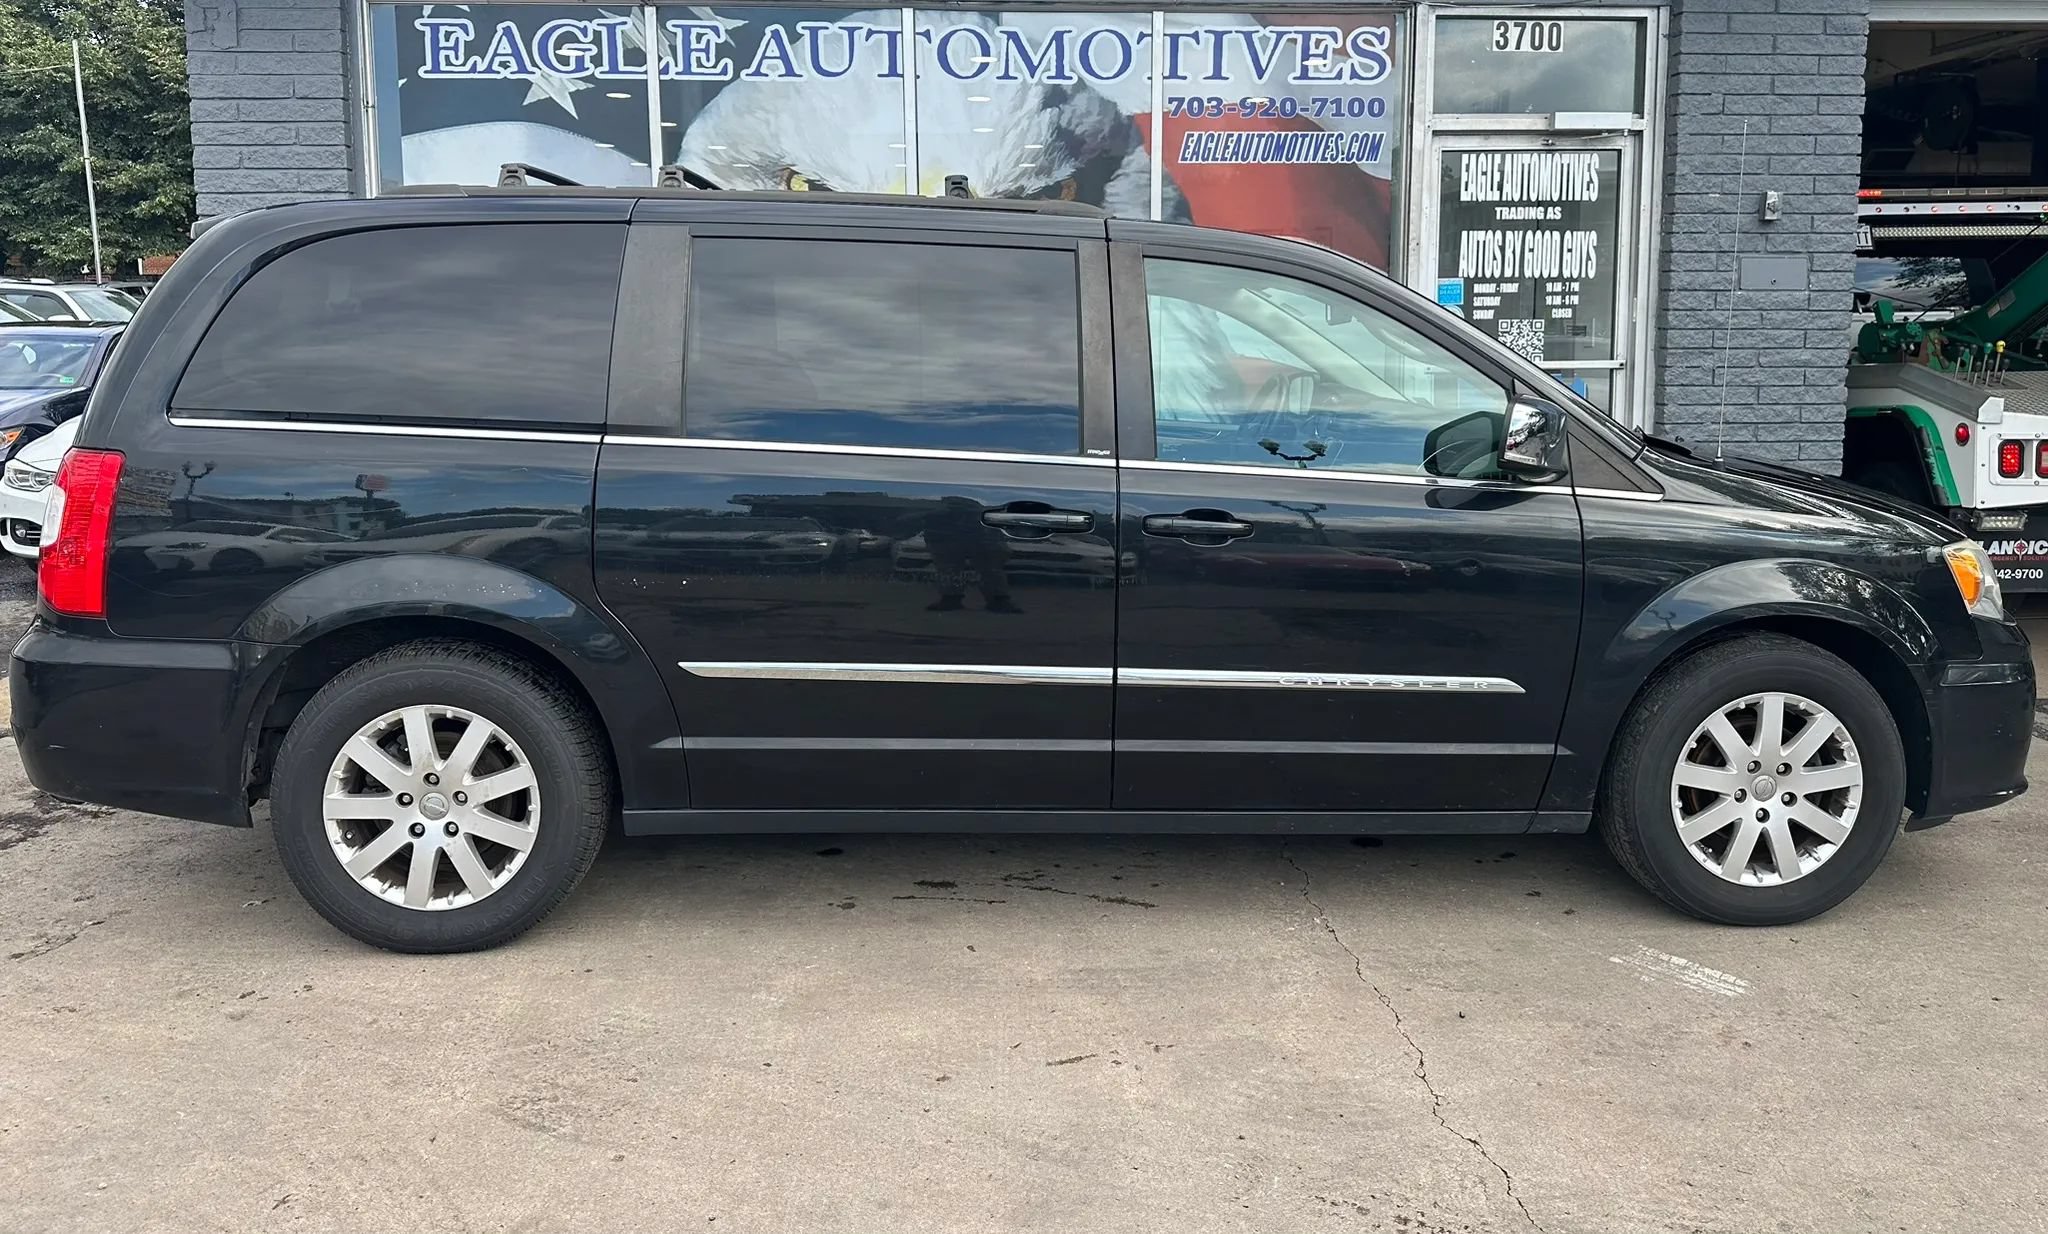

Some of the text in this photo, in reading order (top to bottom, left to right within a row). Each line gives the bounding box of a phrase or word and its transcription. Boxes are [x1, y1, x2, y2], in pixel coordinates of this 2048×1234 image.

[1495, 21, 1562, 51] 3700
[417, 19, 1391, 84] EAGLE AUTOMOTIVES
[1167, 96, 1386, 118] 703-920-7100
[1179, 131, 1386, 164] EAGLEAUTOMOTIVES.COM
[1460, 153, 1599, 202] EAGLE AUTOMOTIVES
[1495, 206, 1562, 220] TRADING AS
[1458, 230, 1598, 279] AUTOS BY GOOD GUYS
[1473, 283, 1496, 293] MONDAY
[1500, 282, 1519, 293] FRIDAY
[1473, 296, 1501, 306] SATURDAY
[1472, 309, 1495, 320] SUNDAY
[1551, 308, 1573, 318] CLOSED
[1279, 676, 1488, 689] CHRYSLER
